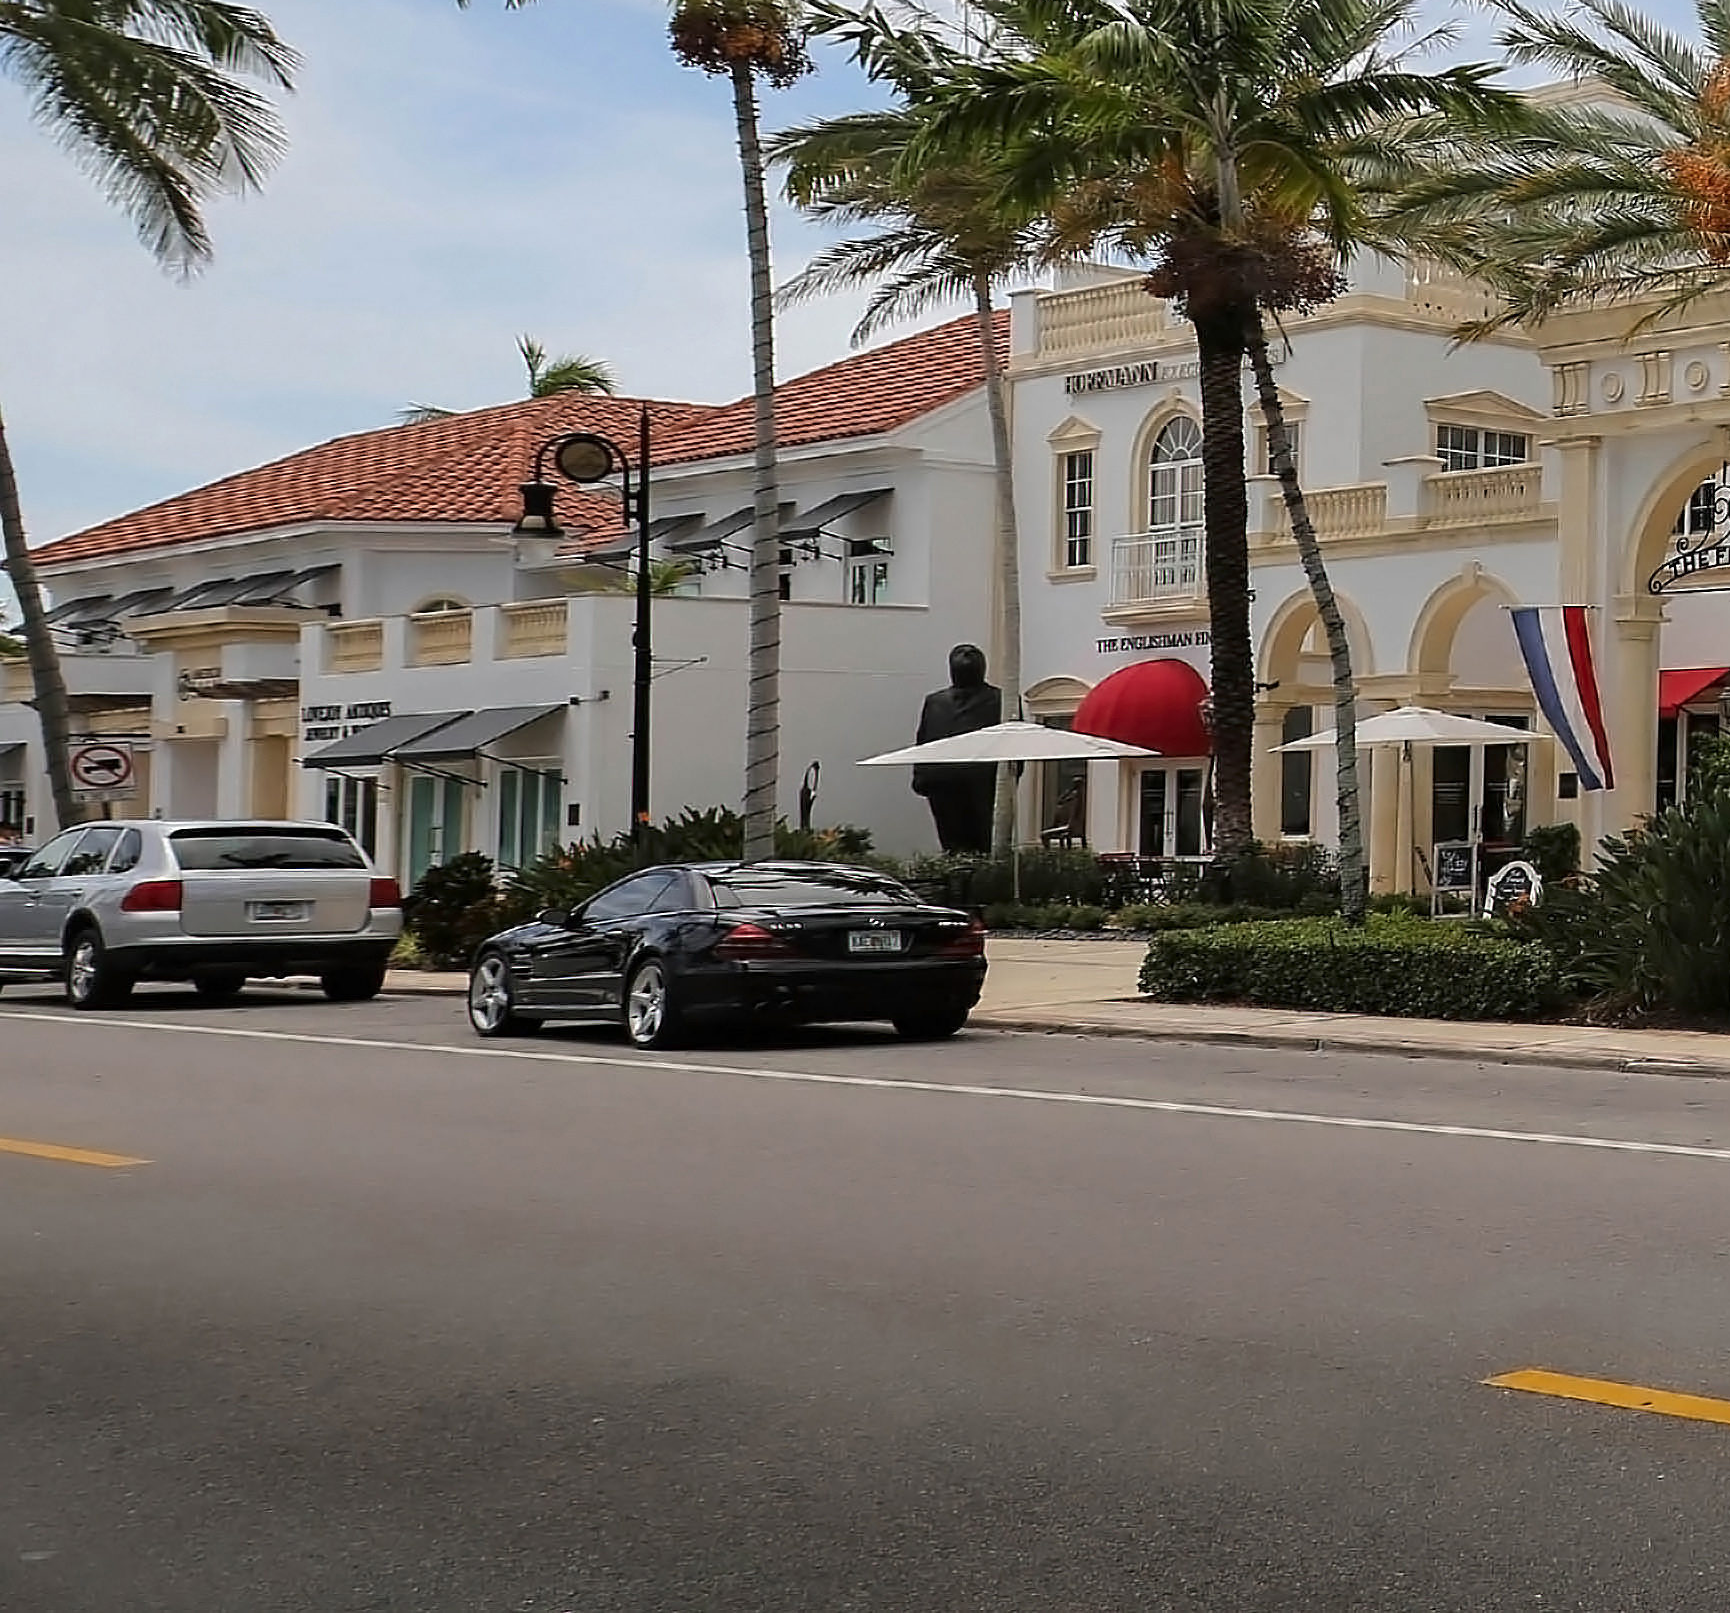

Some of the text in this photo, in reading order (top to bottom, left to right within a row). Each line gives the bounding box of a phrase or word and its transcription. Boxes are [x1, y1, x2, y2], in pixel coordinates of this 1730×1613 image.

[1669, 550, 1709, 578] THE
[1096, 638, 1118, 653] THE
[1121, 634, 1193, 651] ENGLISHMAN
